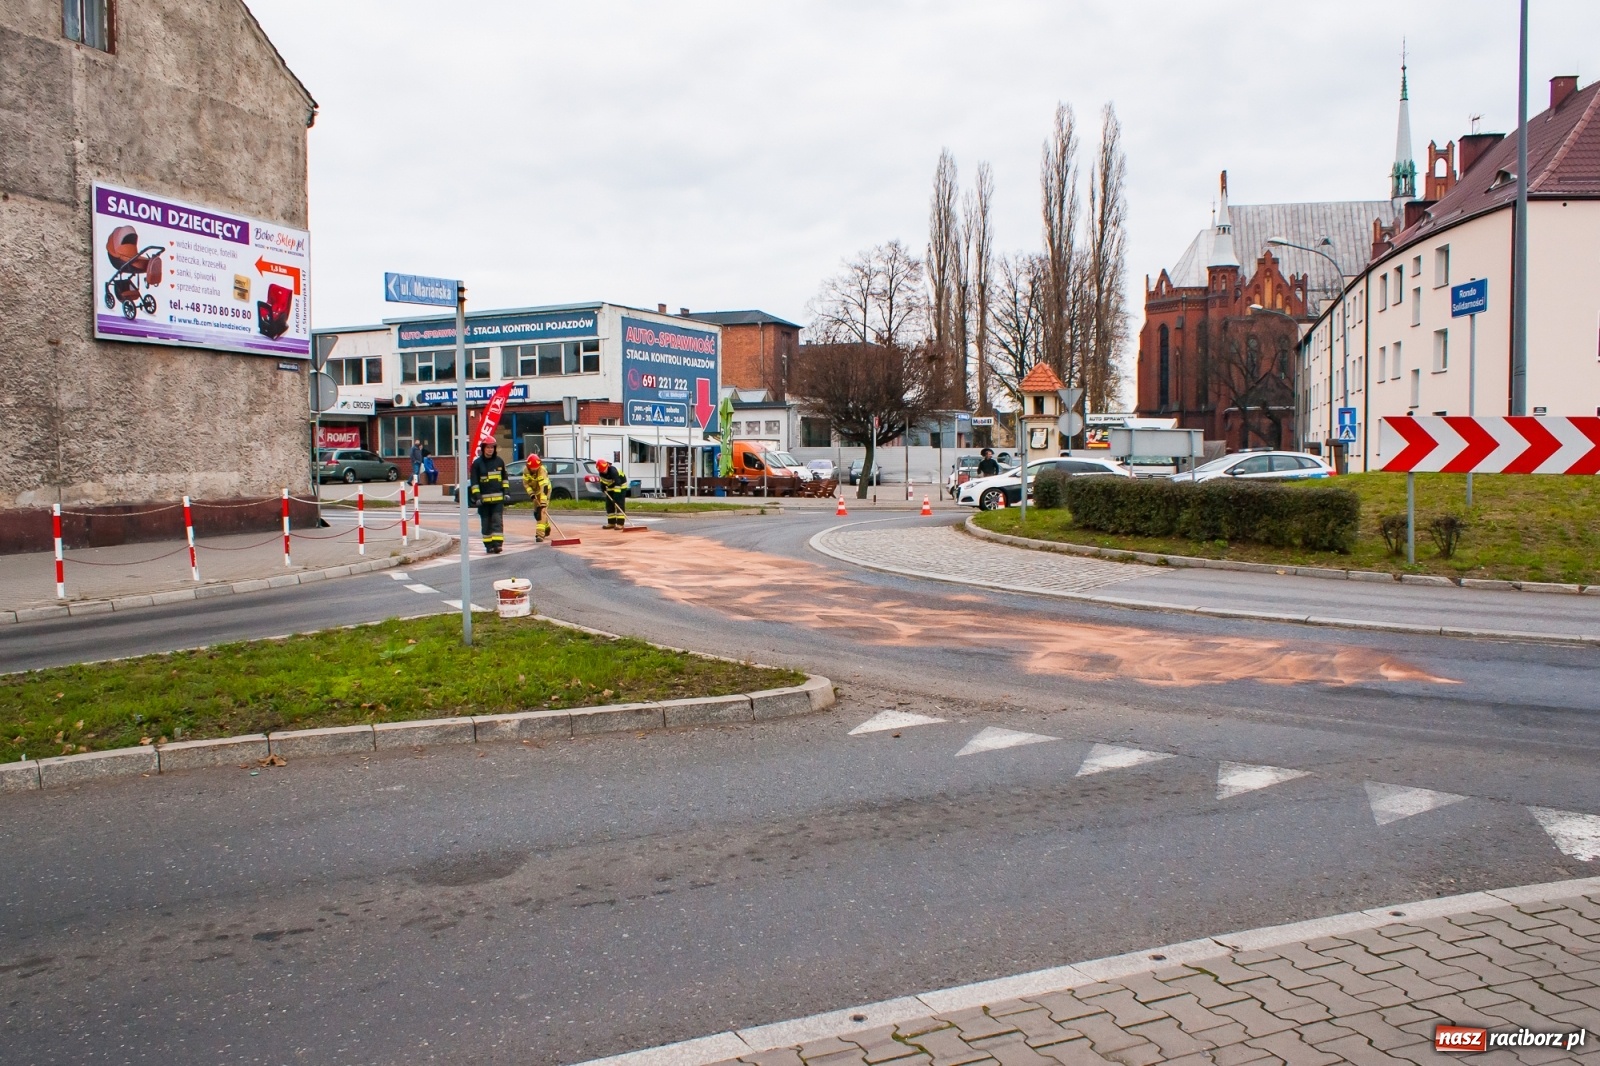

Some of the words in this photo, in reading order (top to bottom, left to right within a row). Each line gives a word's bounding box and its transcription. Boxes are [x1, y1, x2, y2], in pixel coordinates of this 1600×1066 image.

[107, 196, 162, 222] SALON
[168, 209, 241, 240] DZIECIĘCY
[176, 240, 193, 250] wózki
[220, 247, 238, 259] foteliki
[201, 287, 221, 296] ratalna
[401, 280, 411, 296] ul.
[414, 281, 452, 300] Mariańska
[1459, 287, 1477, 299] Rondo
[169, 299, 184, 311] tel.
[185, 302, 200, 313] +48
[202, 303, 217, 315] 730
[219, 306, 229, 317] 80
[231, 308, 240, 318] 50
[242, 310, 252, 320] 80
[1452, 297, 1485, 312] Solidarności
[473, 325, 501, 335] STACJA
[502, 322, 543, 333] KONTROLI
[546, 317, 594, 331] POJAZDÓW
[626, 326, 716, 355] AUTO-SPRAWNOŚĆ
[626, 348, 650, 361] STACJA
[650, 352, 682, 366] KONTROLI
[683, 357, 716, 370] POJAZDÓW
[642, 374, 656, 387] 691
[659, 376, 672, 389] 221
[674, 379, 688, 390] 222
[425, 391, 449, 400] STACJA
[452, 389, 484, 399] KTROLI
[353, 401, 373, 409] CROSSY
[326, 432, 357, 443] ROMET
